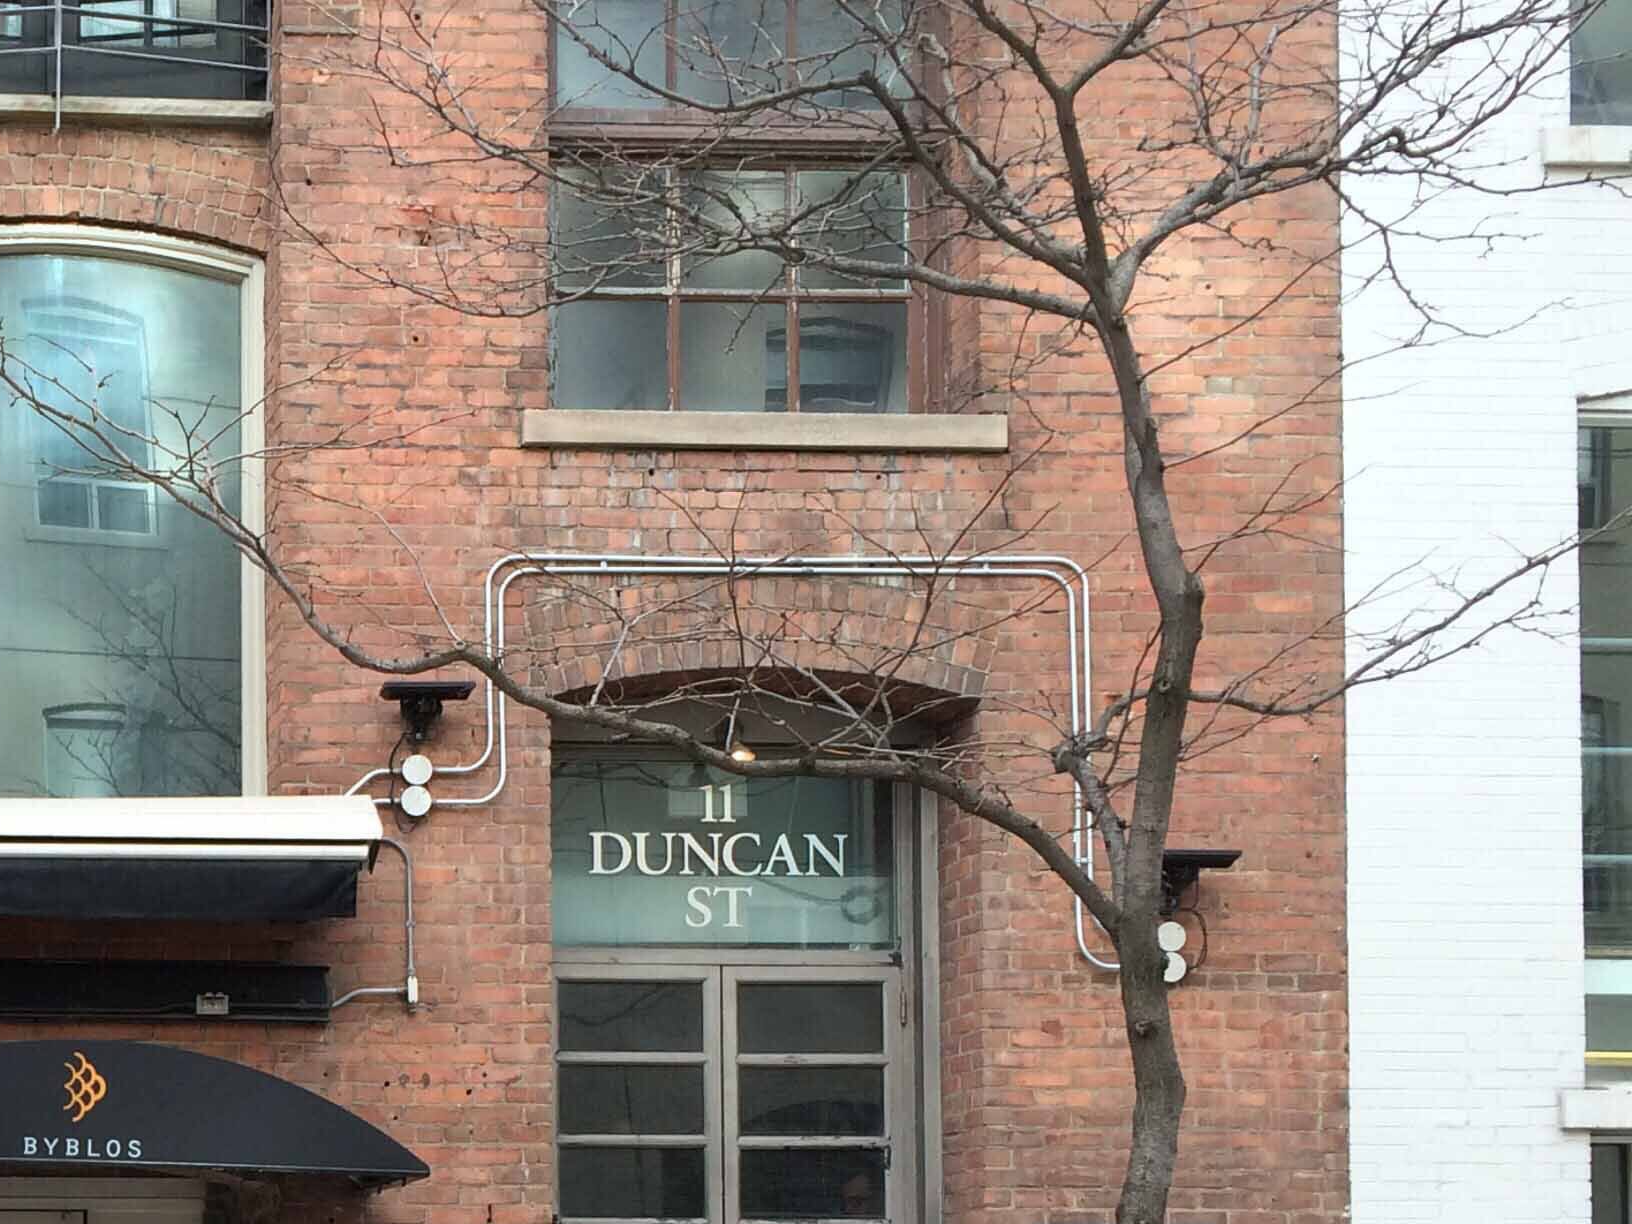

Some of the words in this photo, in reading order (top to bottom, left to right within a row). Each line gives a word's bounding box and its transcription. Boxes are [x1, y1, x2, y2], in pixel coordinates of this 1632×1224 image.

[699, 783, 737, 823] 11
[588, 831, 849, 877] DUNCAN
[685, 886, 753, 928] ST
[23, 1136, 142, 1158] BYBLOS
